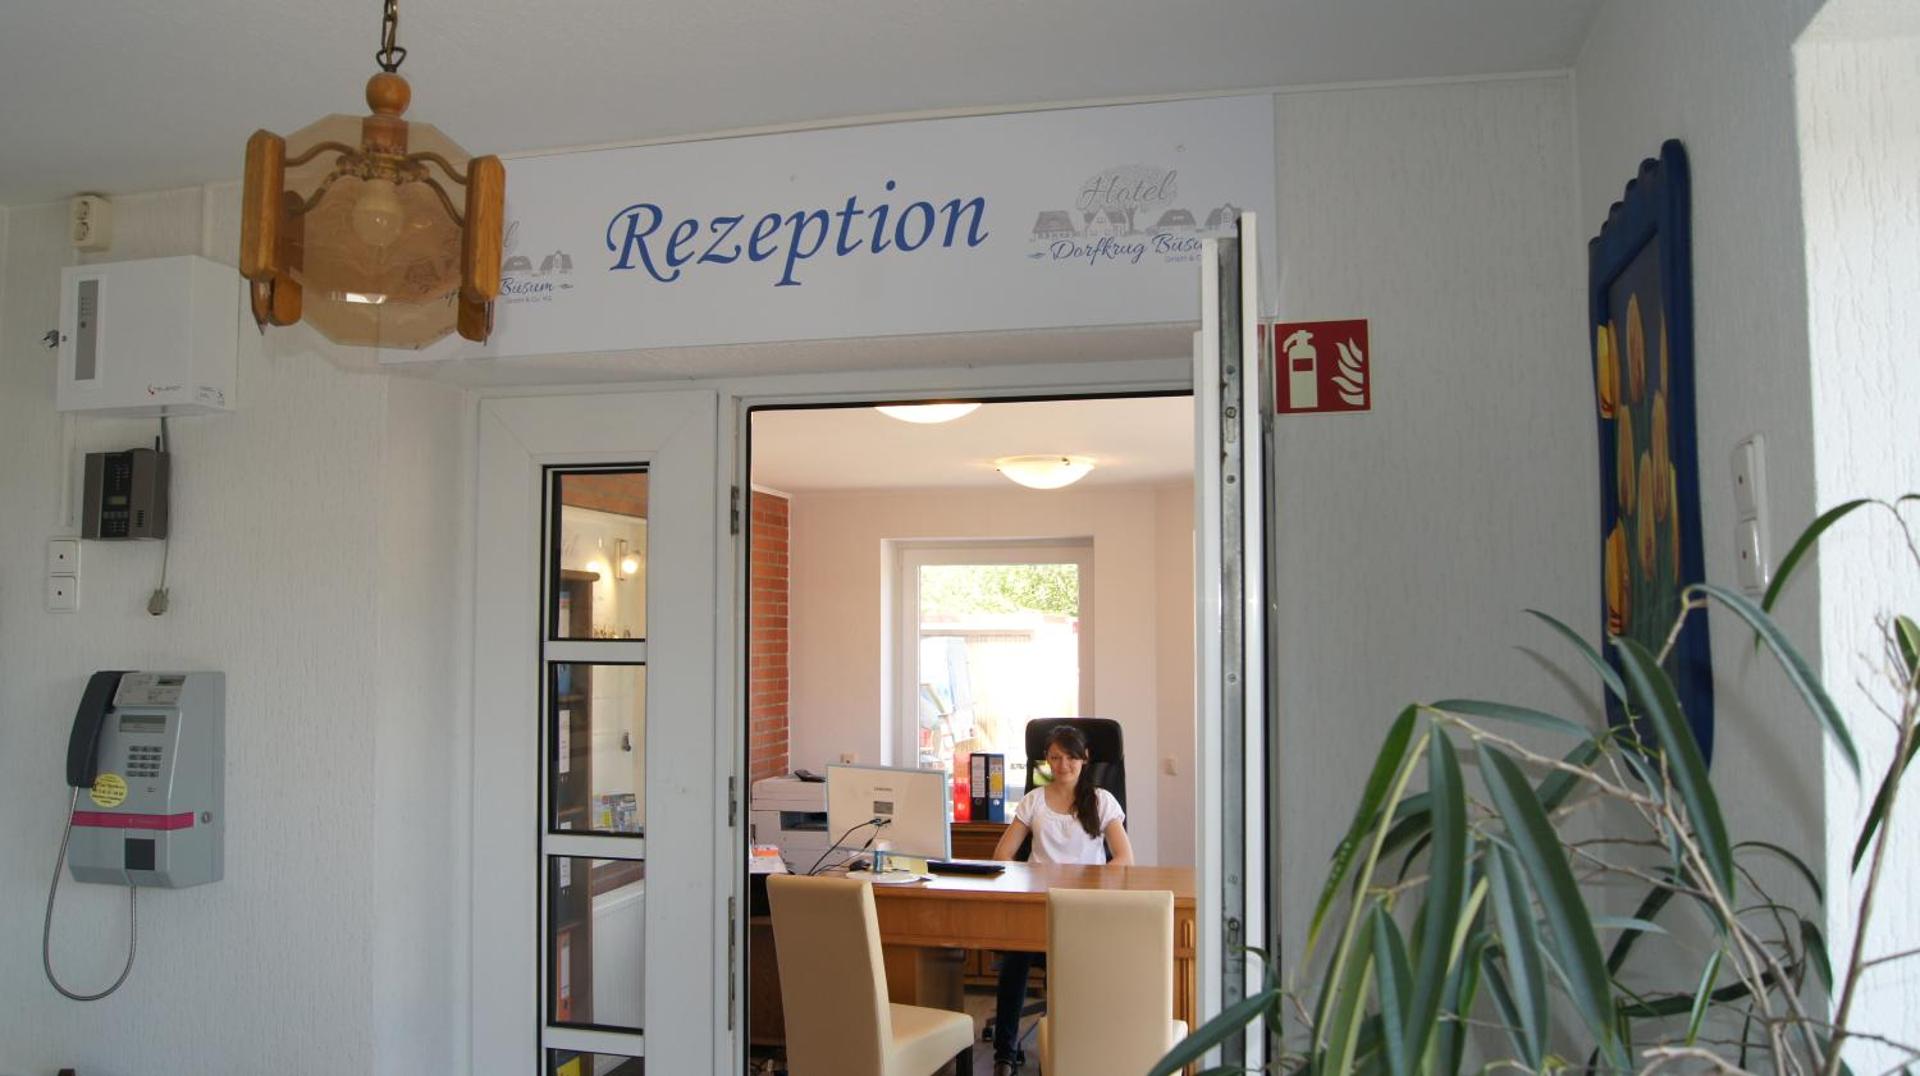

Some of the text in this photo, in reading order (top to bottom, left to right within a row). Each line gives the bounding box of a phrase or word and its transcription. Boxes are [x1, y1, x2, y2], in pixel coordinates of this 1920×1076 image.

[1082, 170, 1177, 206] Hotel
[606, 180, 990, 287] Rezeption
[1050, 233, 1202, 266] Dorfkrug Büsu
